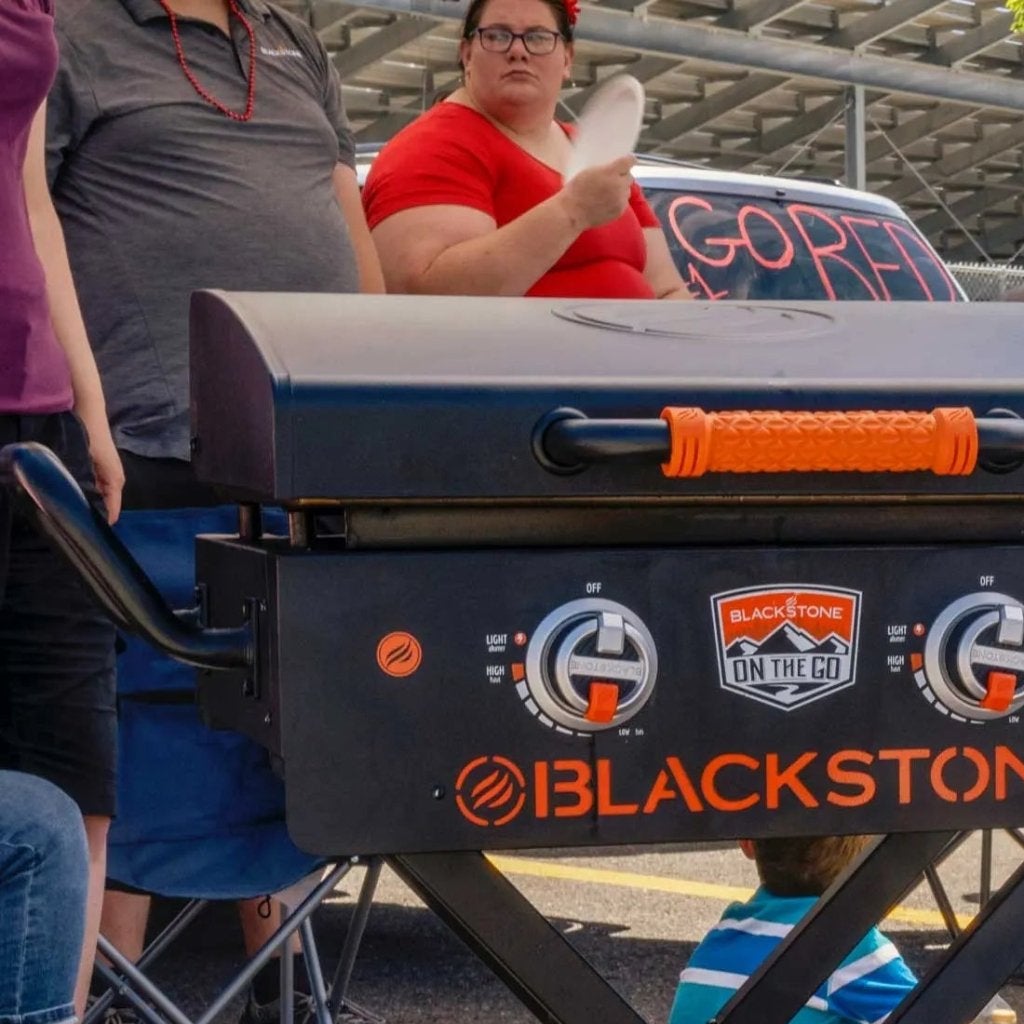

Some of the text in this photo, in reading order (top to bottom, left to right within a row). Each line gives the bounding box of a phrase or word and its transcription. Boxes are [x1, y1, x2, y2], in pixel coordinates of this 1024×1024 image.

[668, 196, 794, 269] GO
[980, 575, 994, 587] OFF
[586, 582, 602, 594] OFF
[730, 605, 843, 623] BLACKSTONE
[887, 625, 907, 636] LIGHT
[486, 634, 507, 645] LIGHT
[887, 655, 904, 665] HIGH
[486, 665, 504, 676] HIGH
[733, 656, 841, 683] ON THE GO
